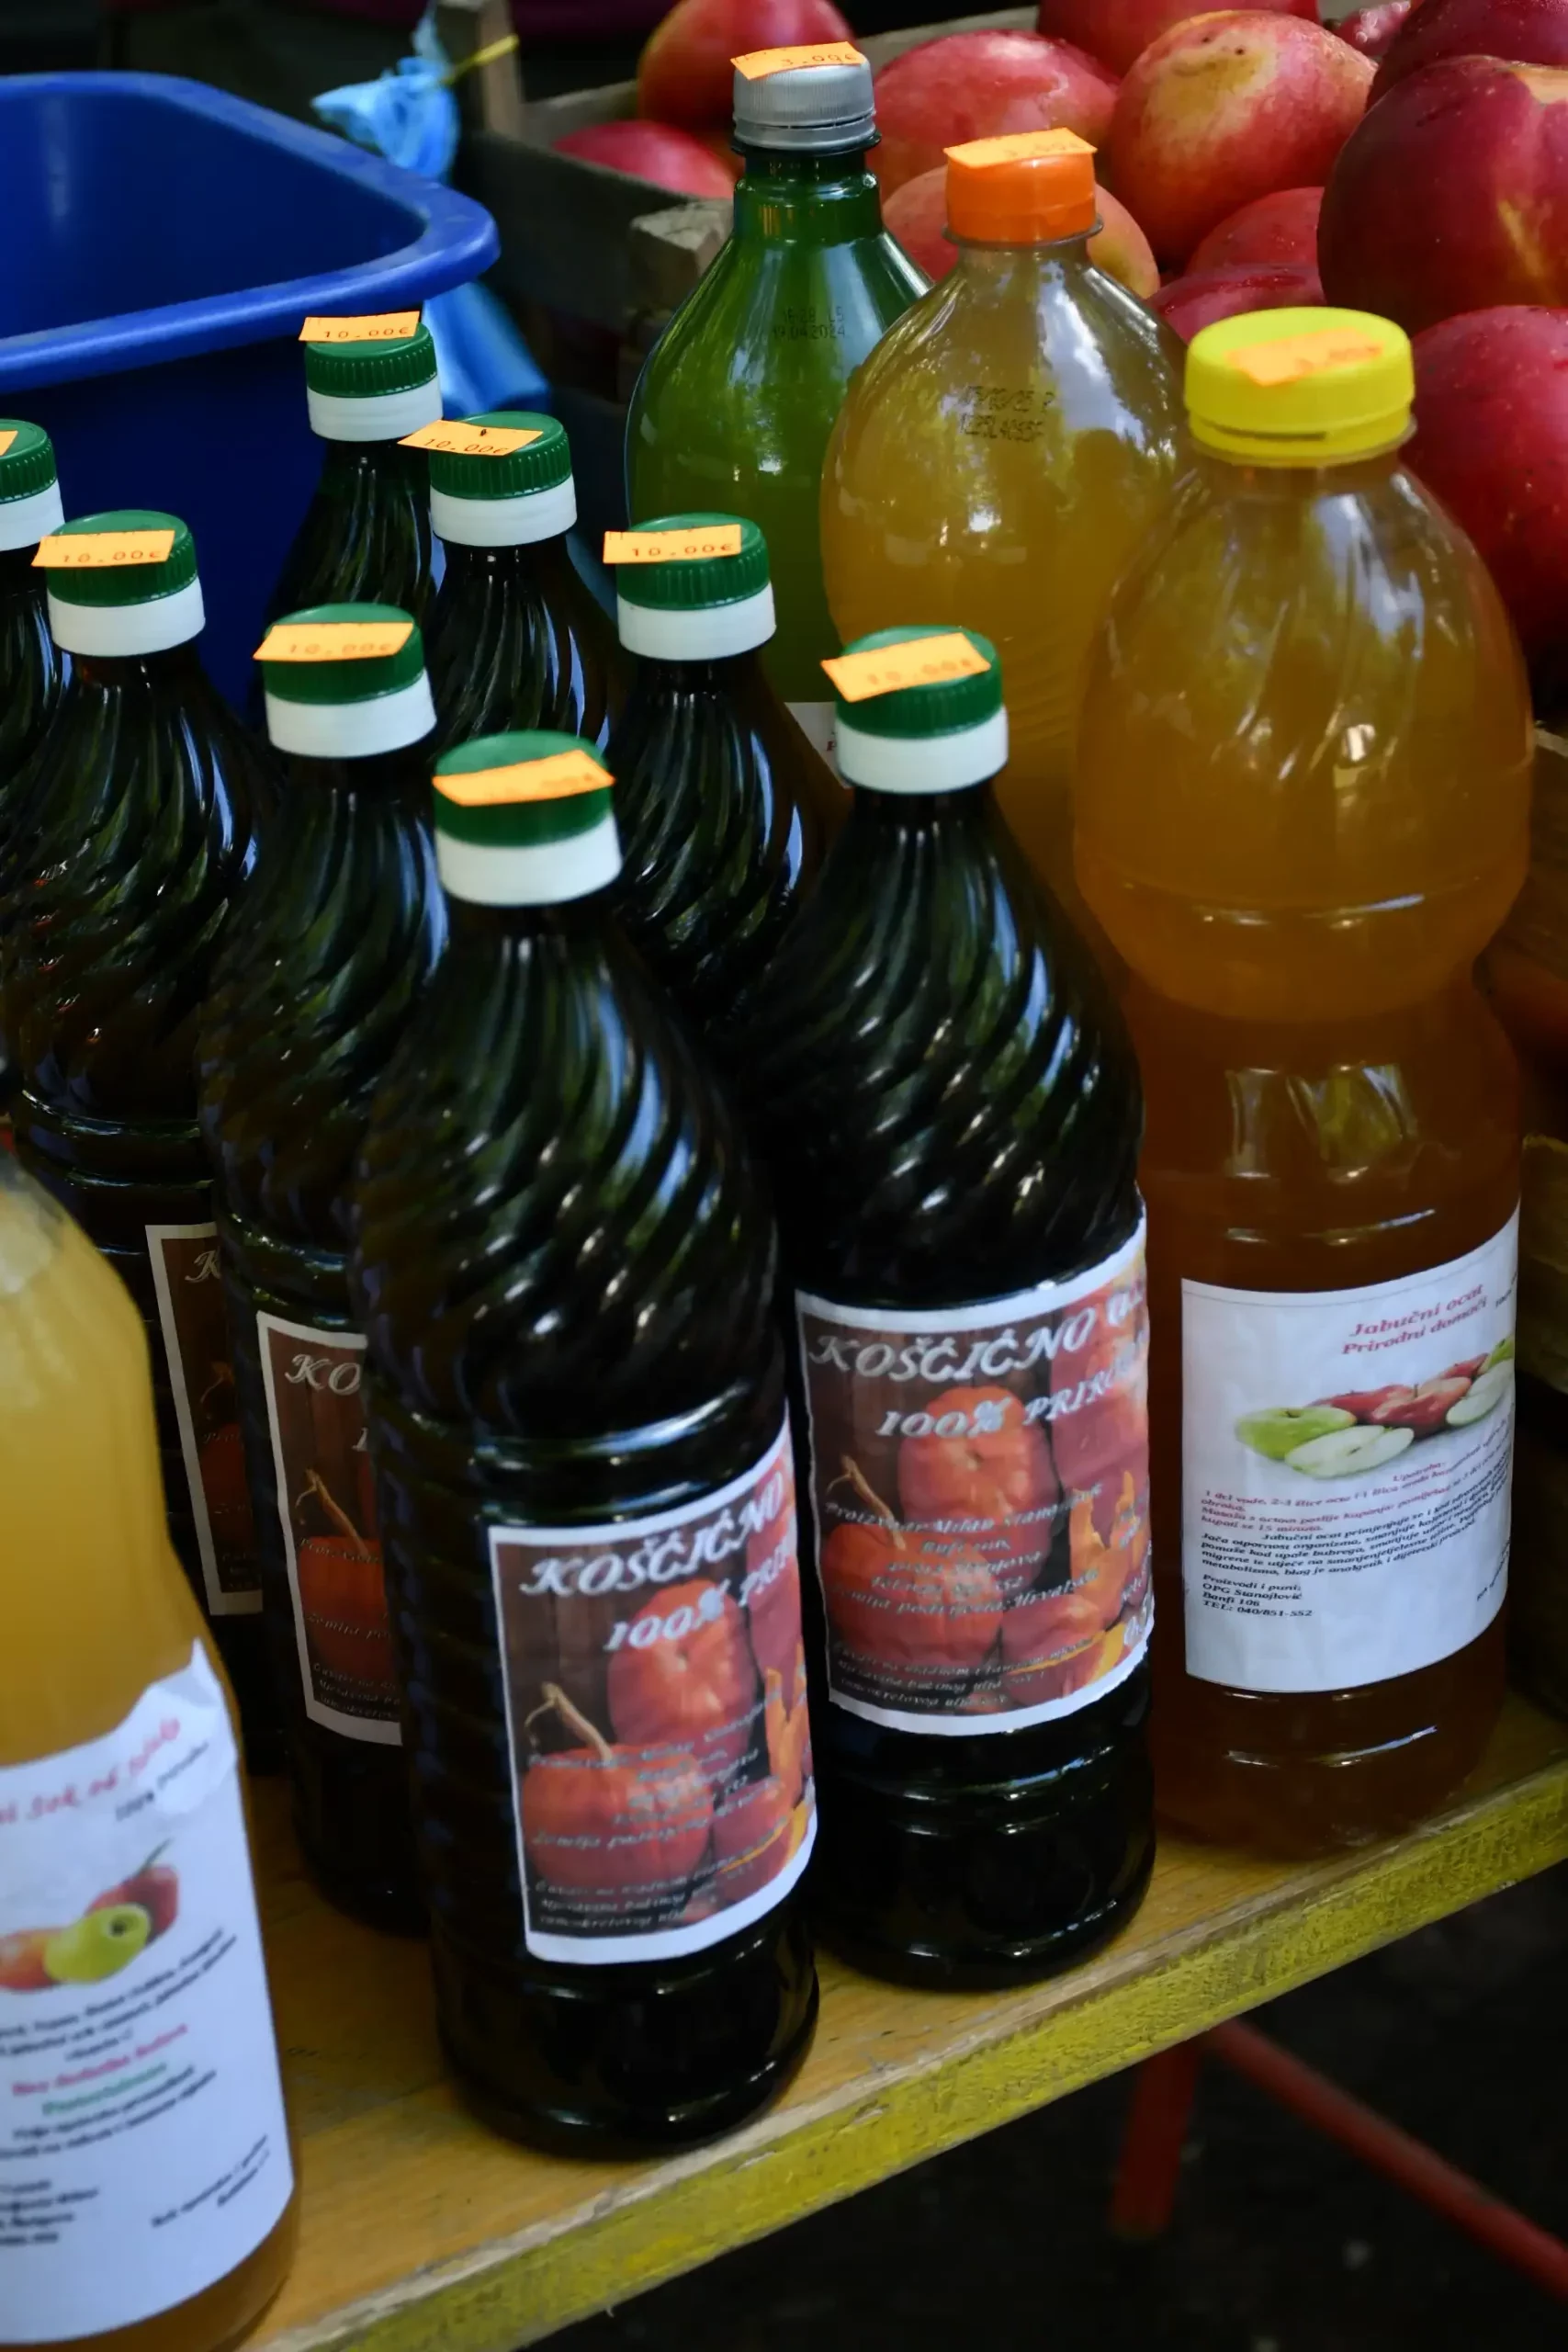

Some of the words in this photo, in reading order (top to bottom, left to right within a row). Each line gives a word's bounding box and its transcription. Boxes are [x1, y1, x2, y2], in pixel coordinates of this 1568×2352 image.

[323, 327, 410, 338] 10.00€
[423, 438, 509, 454] 10.00€
[62, 550, 163, 563] 10.00€
[631, 543, 735, 557] 10.00€
[1349, 1302, 1440, 1337] Jabučni
[1341, 1325, 1425, 1354] Prirodni
[875, 1396, 1011, 1439] 100%
[1201, 1516, 1239, 1528] kupati
[1258, 1523, 1273, 1532] 15
[1201, 1532, 1229, 1544] Jača
[1232, 1537, 1290, 1550] otpornost
[1366, 1524, 1416, 1543] smanjuje
[1261, 1531, 1314, 1541] Jabučni
[1315, 1531, 1342, 1540] ocat
[1201, 1540, 1247, 1555] pomaže
[1249, 1548, 1272, 1558] kod
[1275, 1551, 1309, 1561] upale
[1371, 1532, 1419, 1551] smanjuje
[1201, 1550, 1250, 1565] migrene
[1201, 1559, 1280, 1577] metabolizma,
[1284, 1567, 1311, 1577] blag
[1202, 1574, 1258, 1589] Proizvodi
[1268, 1584, 1302, 1592] puni:
[1202, 1583, 1231, 1595] OPG
[1234, 1589, 1303, 1600] Stanojlović
[1201, 1591, 1235, 1604] Banfi
[1240, 1599, 1260, 1608] 106
[1203, 1600, 1234, 1612] TEL:
[1236, 1606, 1314, 1618] 040/851-552
